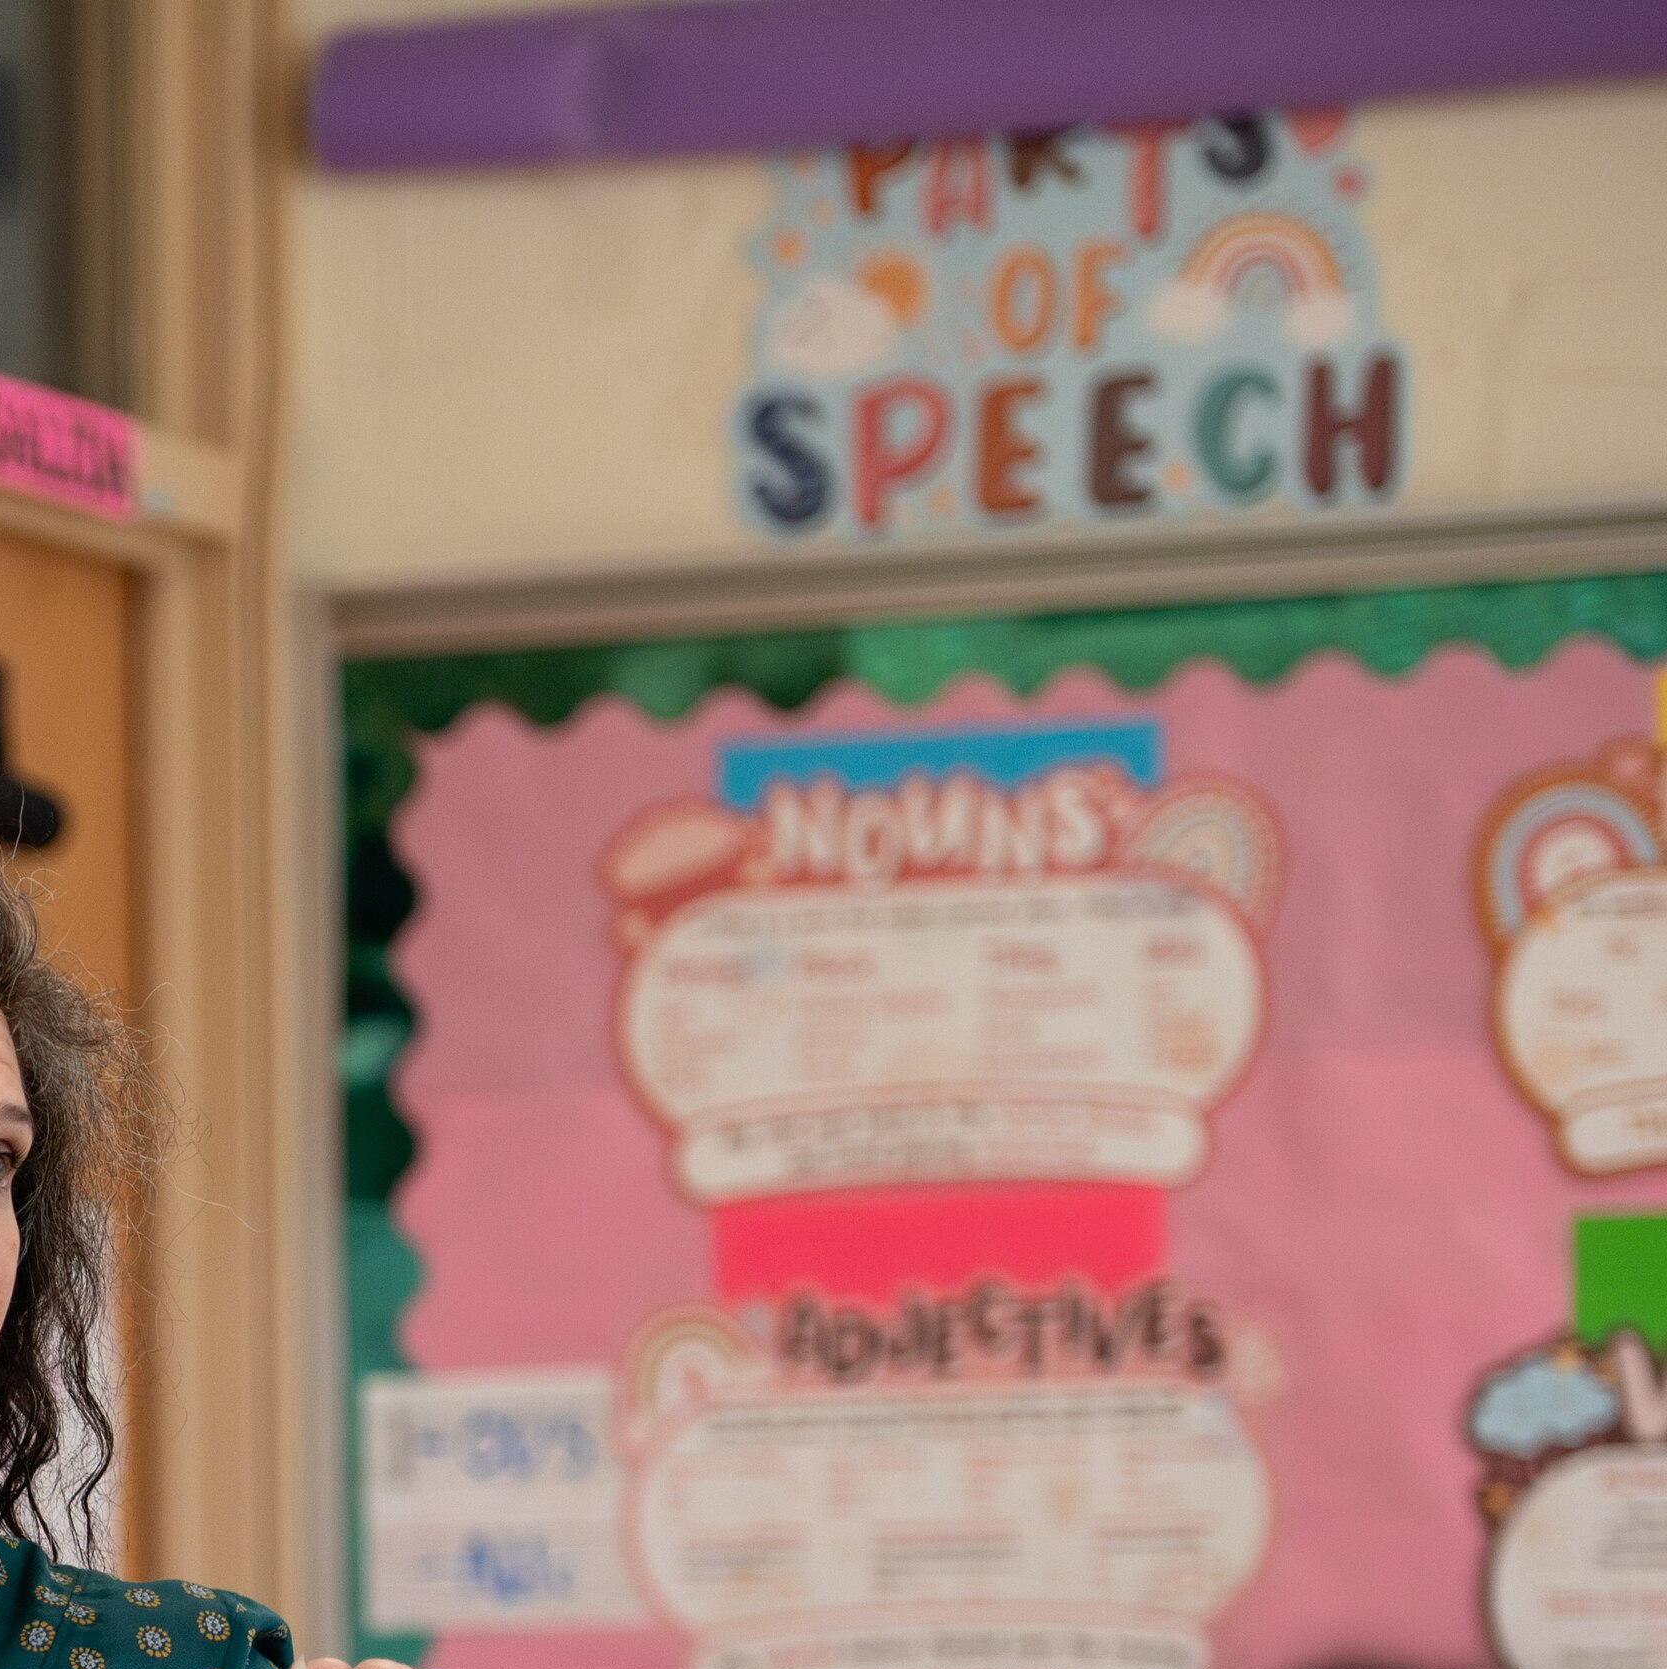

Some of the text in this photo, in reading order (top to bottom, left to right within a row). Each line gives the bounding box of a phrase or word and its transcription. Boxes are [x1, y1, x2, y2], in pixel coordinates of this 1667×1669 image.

[989, 238, 1129, 353] OF
[745, 350, 1402, 532] SPEECH
[769, 775, 1105, 877] NOUNS
[777, 1279, 1227, 1381] ADJECTIVES
